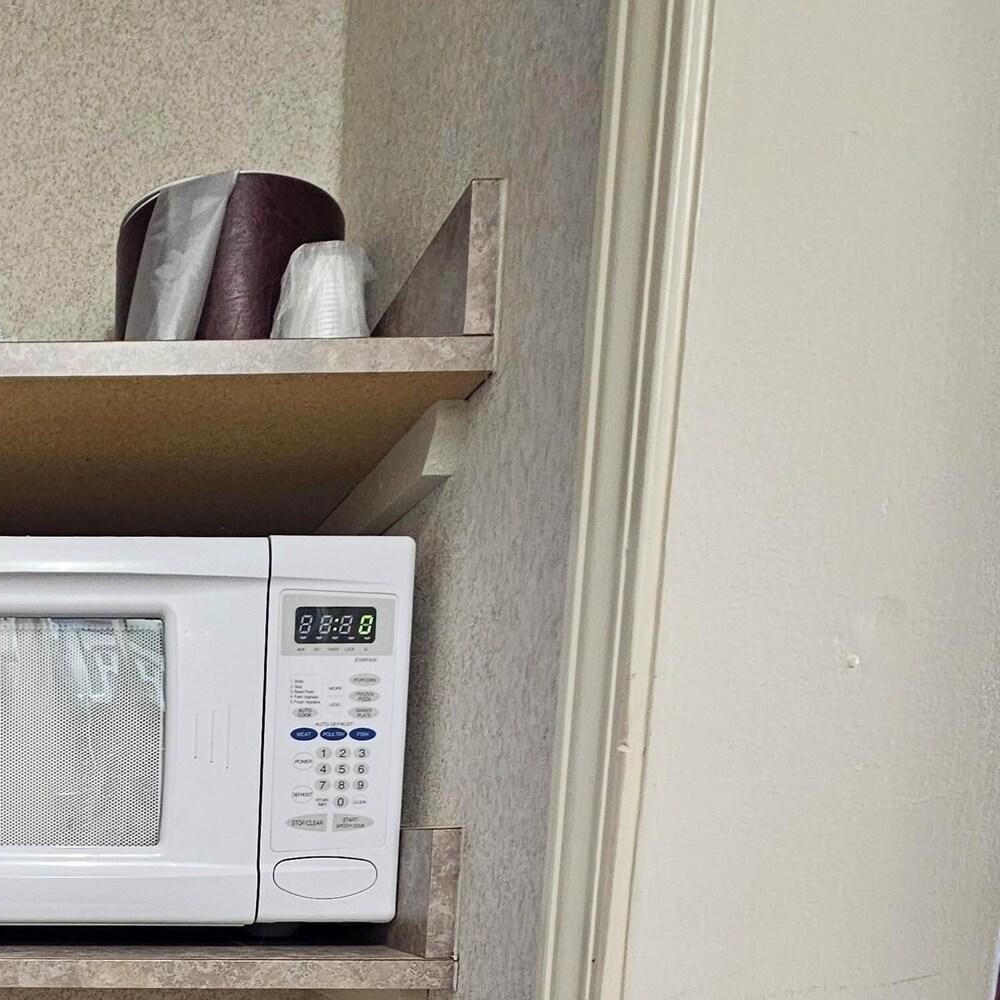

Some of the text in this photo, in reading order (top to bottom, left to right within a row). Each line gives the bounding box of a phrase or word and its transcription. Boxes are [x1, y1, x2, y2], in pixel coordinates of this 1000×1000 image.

[321, 748, 366, 758] 1 2 3
[319, 764, 365, 774] 4 5 6
[319, 780, 364, 790] 7 8 9
[337, 797, 345, 807] 0
